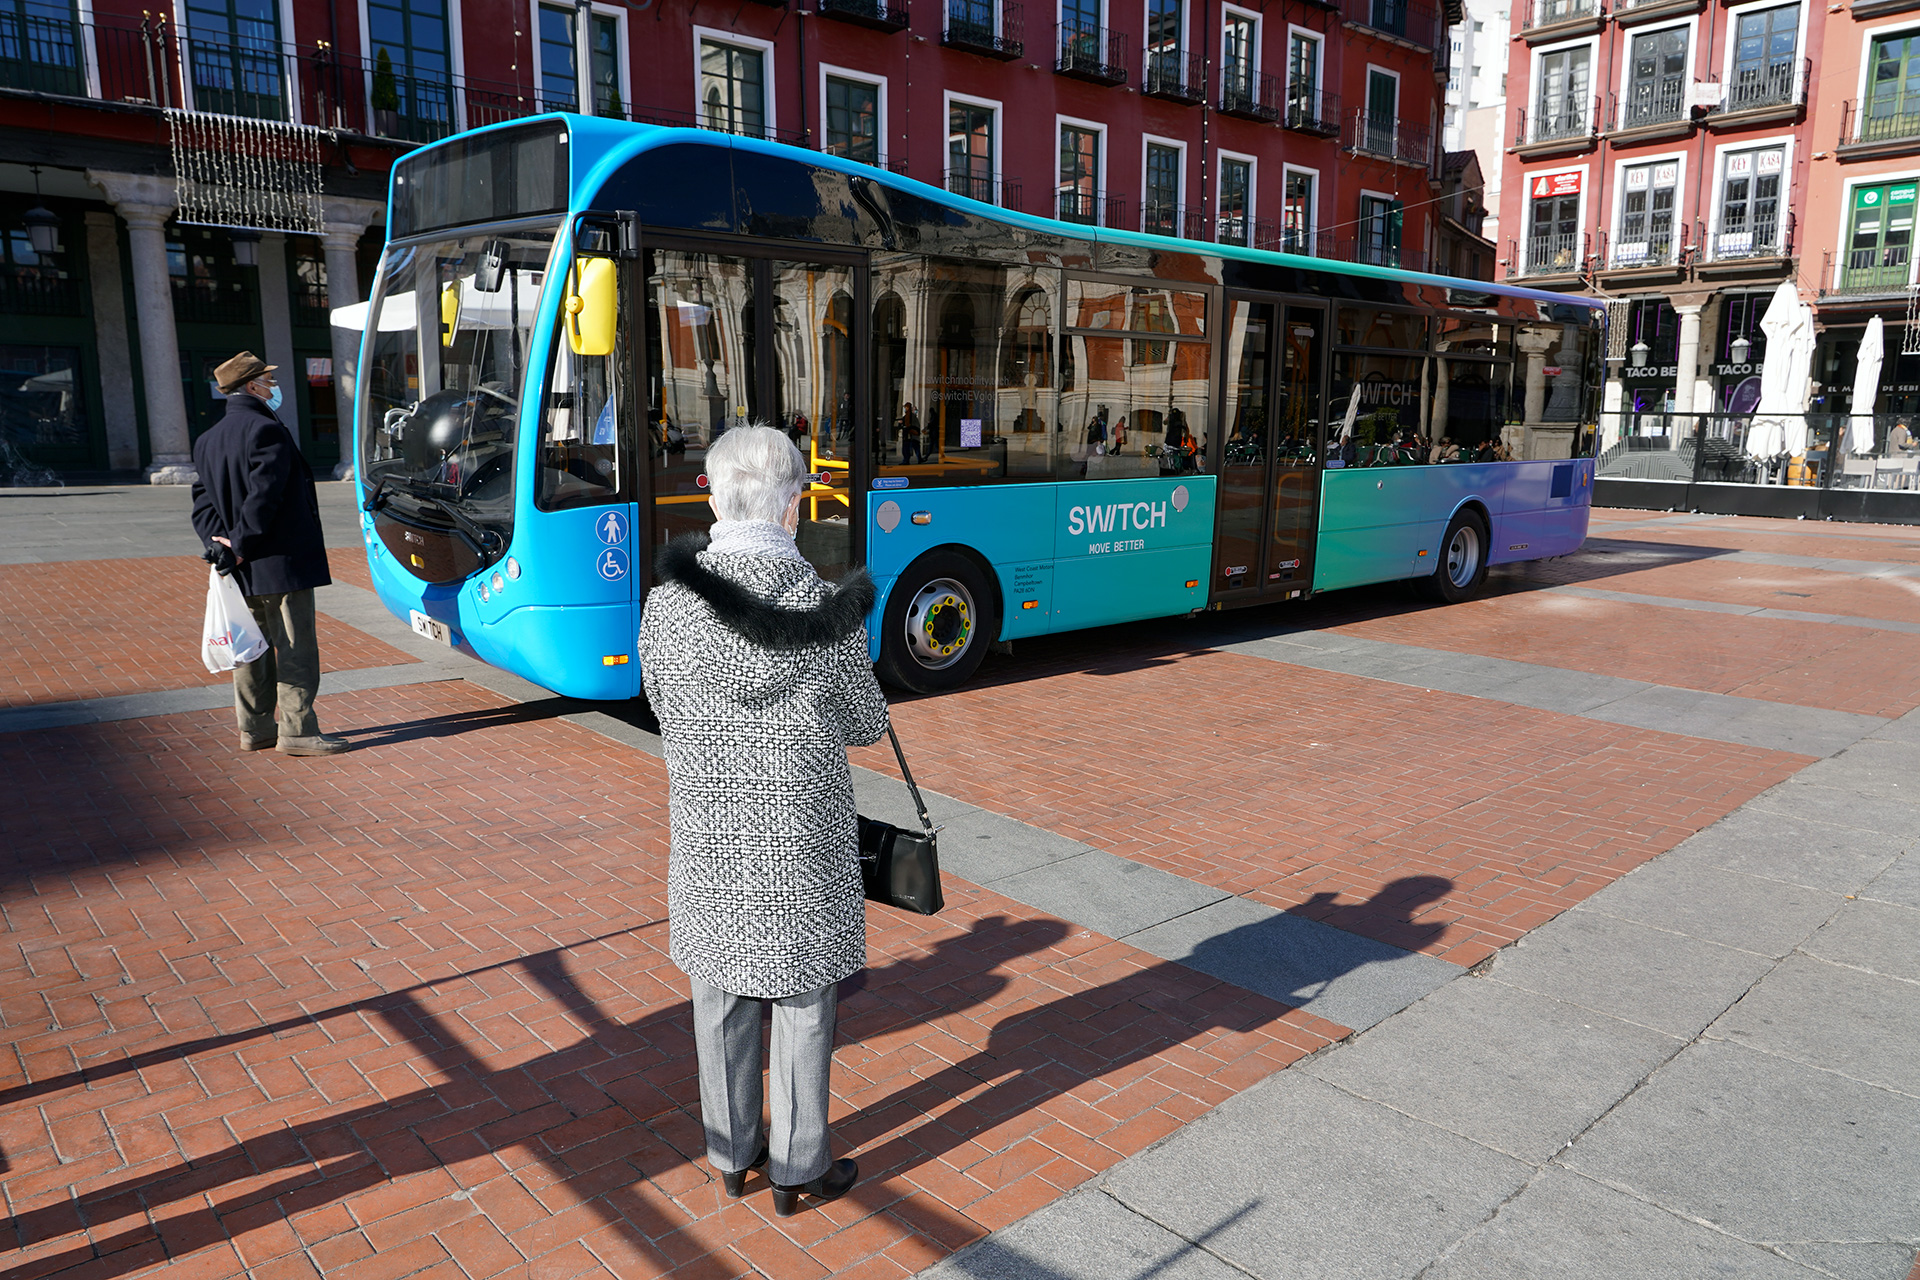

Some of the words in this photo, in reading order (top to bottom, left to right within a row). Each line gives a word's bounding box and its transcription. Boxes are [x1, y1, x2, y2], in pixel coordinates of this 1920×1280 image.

[1731, 156, 1747, 172] KEY
[1625, 366, 1658, 378] TACO
[1660, 365, 1678, 377] BE
[1717, 363, 1753, 375] TACO
[1067, 501, 1167, 535] SWITCH
[1088, 542, 1110, 555] MOVE
[1113, 539, 1144, 552] BETTER
